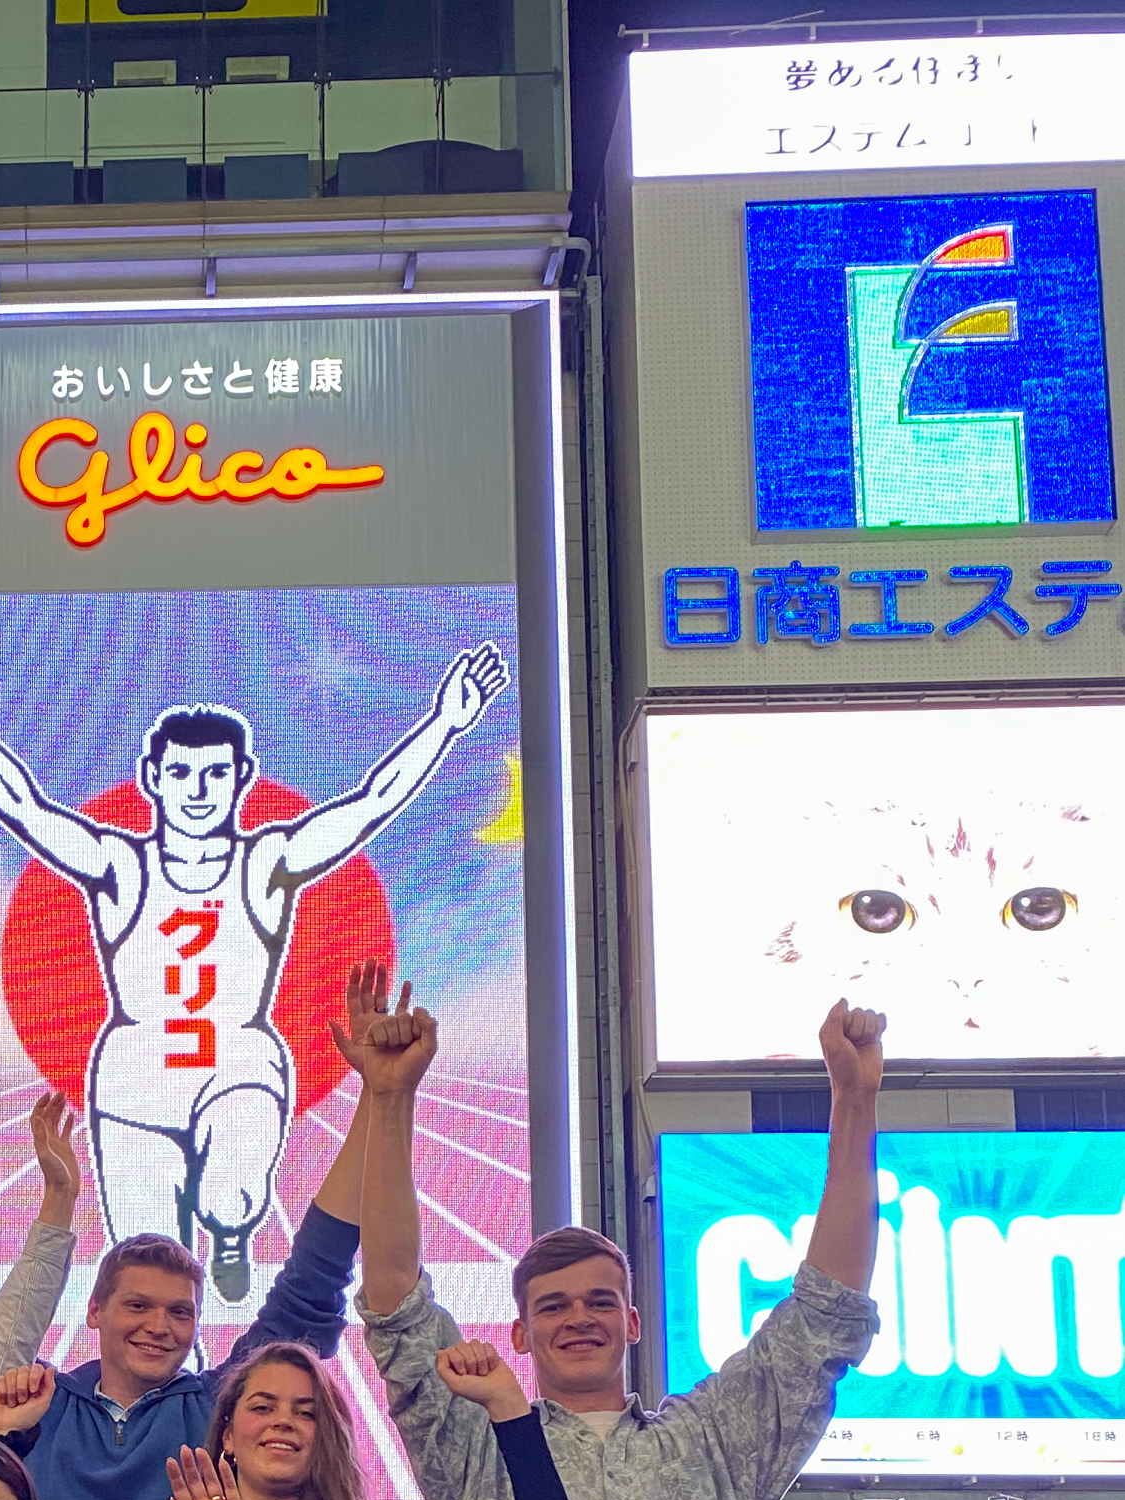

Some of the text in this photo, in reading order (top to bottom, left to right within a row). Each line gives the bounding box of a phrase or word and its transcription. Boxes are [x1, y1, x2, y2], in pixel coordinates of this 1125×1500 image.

[52, 357, 343, 399] おいしさと健康
[18, 412, 385, 548] Glico
[664, 560, 1123, 646] 日商エステ
[158, 900, 224, 1068] グリコ
